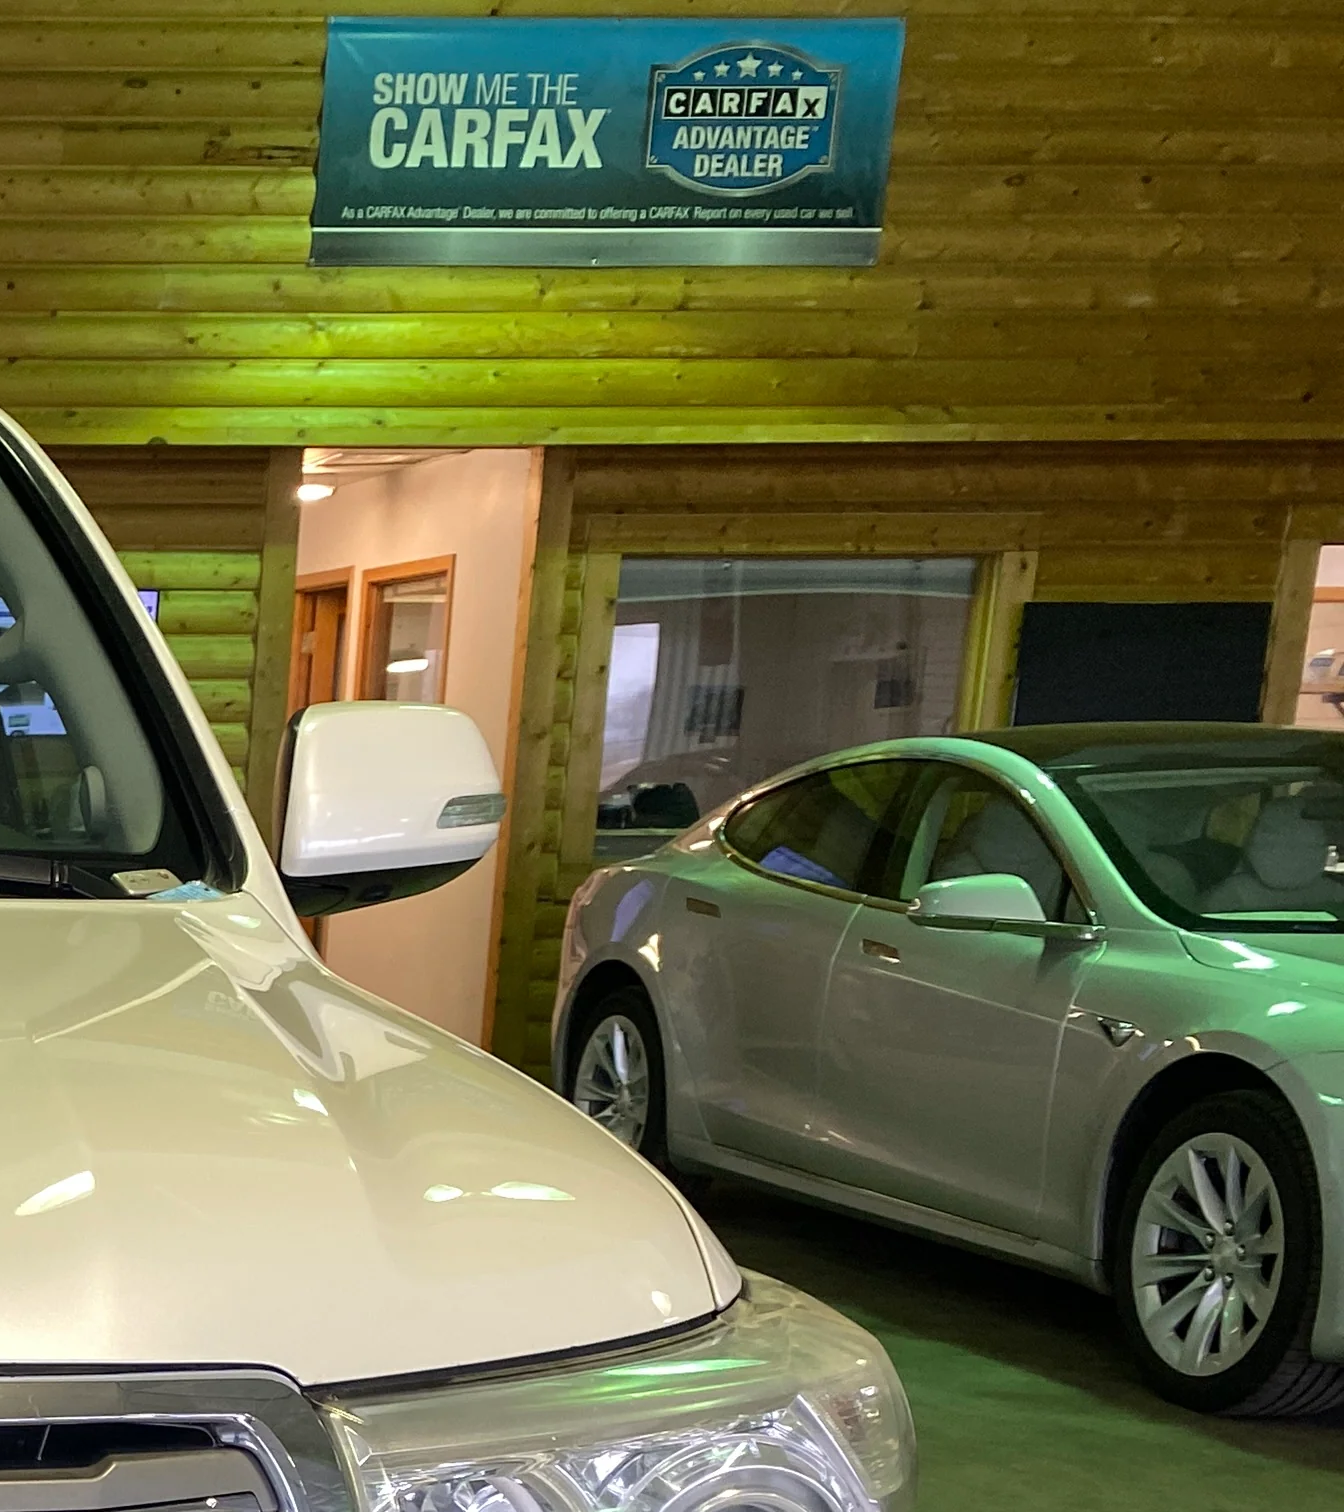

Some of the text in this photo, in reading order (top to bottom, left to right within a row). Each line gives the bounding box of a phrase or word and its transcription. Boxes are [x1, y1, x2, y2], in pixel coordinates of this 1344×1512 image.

[373, 72, 579, 105] SHOW ME THE
[668, 92, 822, 118] CARFAX
[369, 107, 606, 168] CARFAX
[672, 125, 810, 150] ADVANTAGE
[693, 153, 783, 177] DEALER
[341, 206, 355, 219] As
[356, 208, 363, 219] a
[366, 206, 406, 219] CARFAX
[498, 208, 513, 219] we
[515, 208, 532, 219] are
[534, 207, 586, 219] committed
[587, 208, 598, 219] to
[599, 207, 638, 222] offering
[639, 209, 647, 219] a
[649, 206, 691, 219] CARFAX
[694, 206, 727, 221] Report
[728, 208, 742, 219] on
[744, 208, 772, 222] every
[773, 207, 798, 219] used
[799, 208, 816, 219] car
